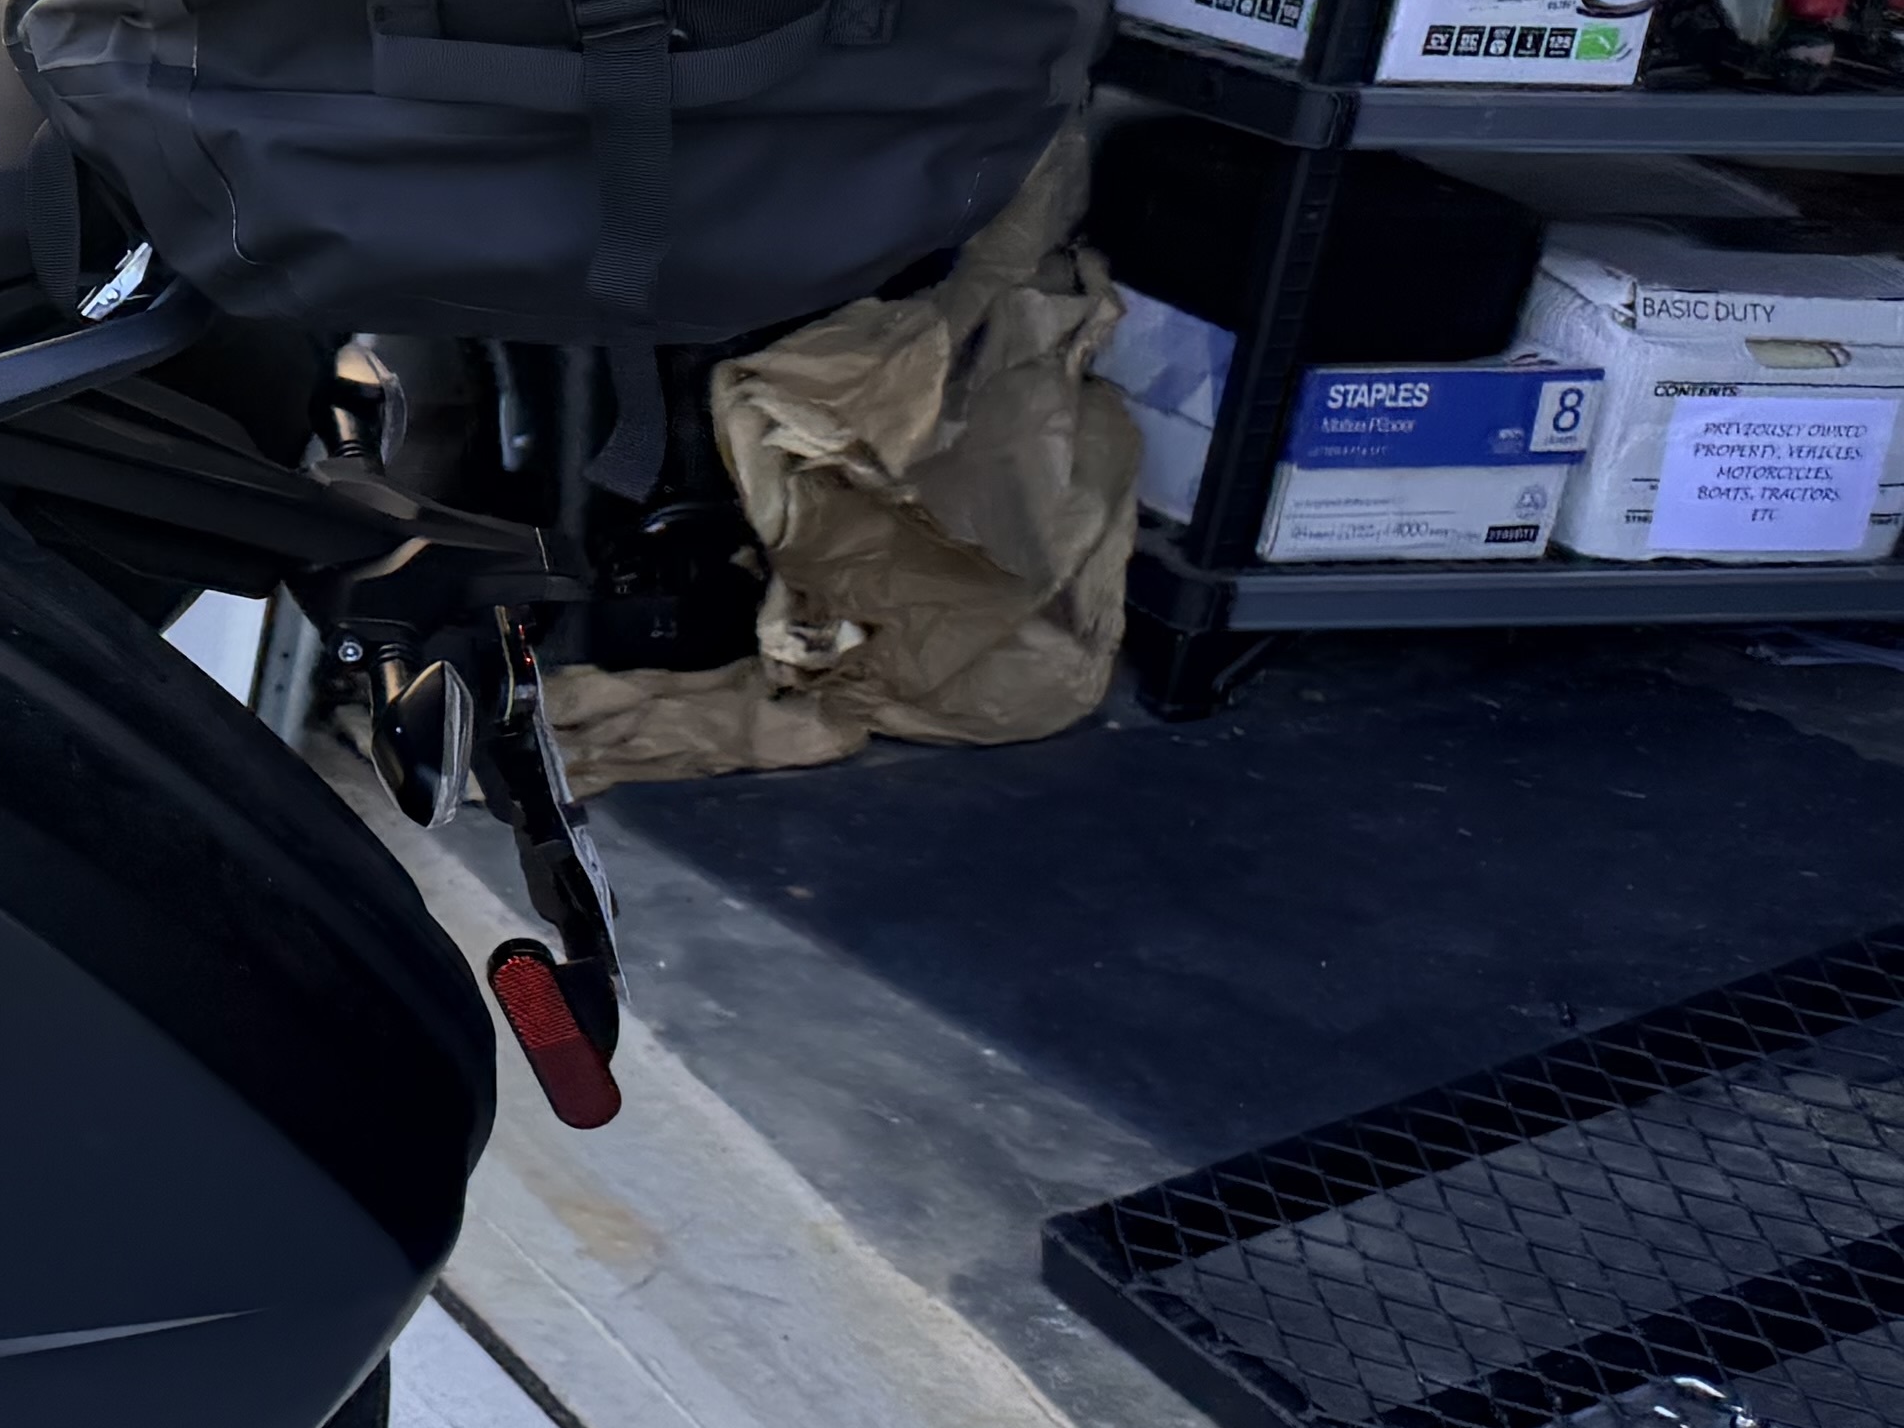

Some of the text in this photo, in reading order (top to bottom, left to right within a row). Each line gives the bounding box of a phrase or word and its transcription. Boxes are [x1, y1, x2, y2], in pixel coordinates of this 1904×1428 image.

[1642, 296, 1776, 323] BASIC DUTY
[1327, 382, 1431, 409] STAPLES
[1552, 387, 1585, 434] 8
